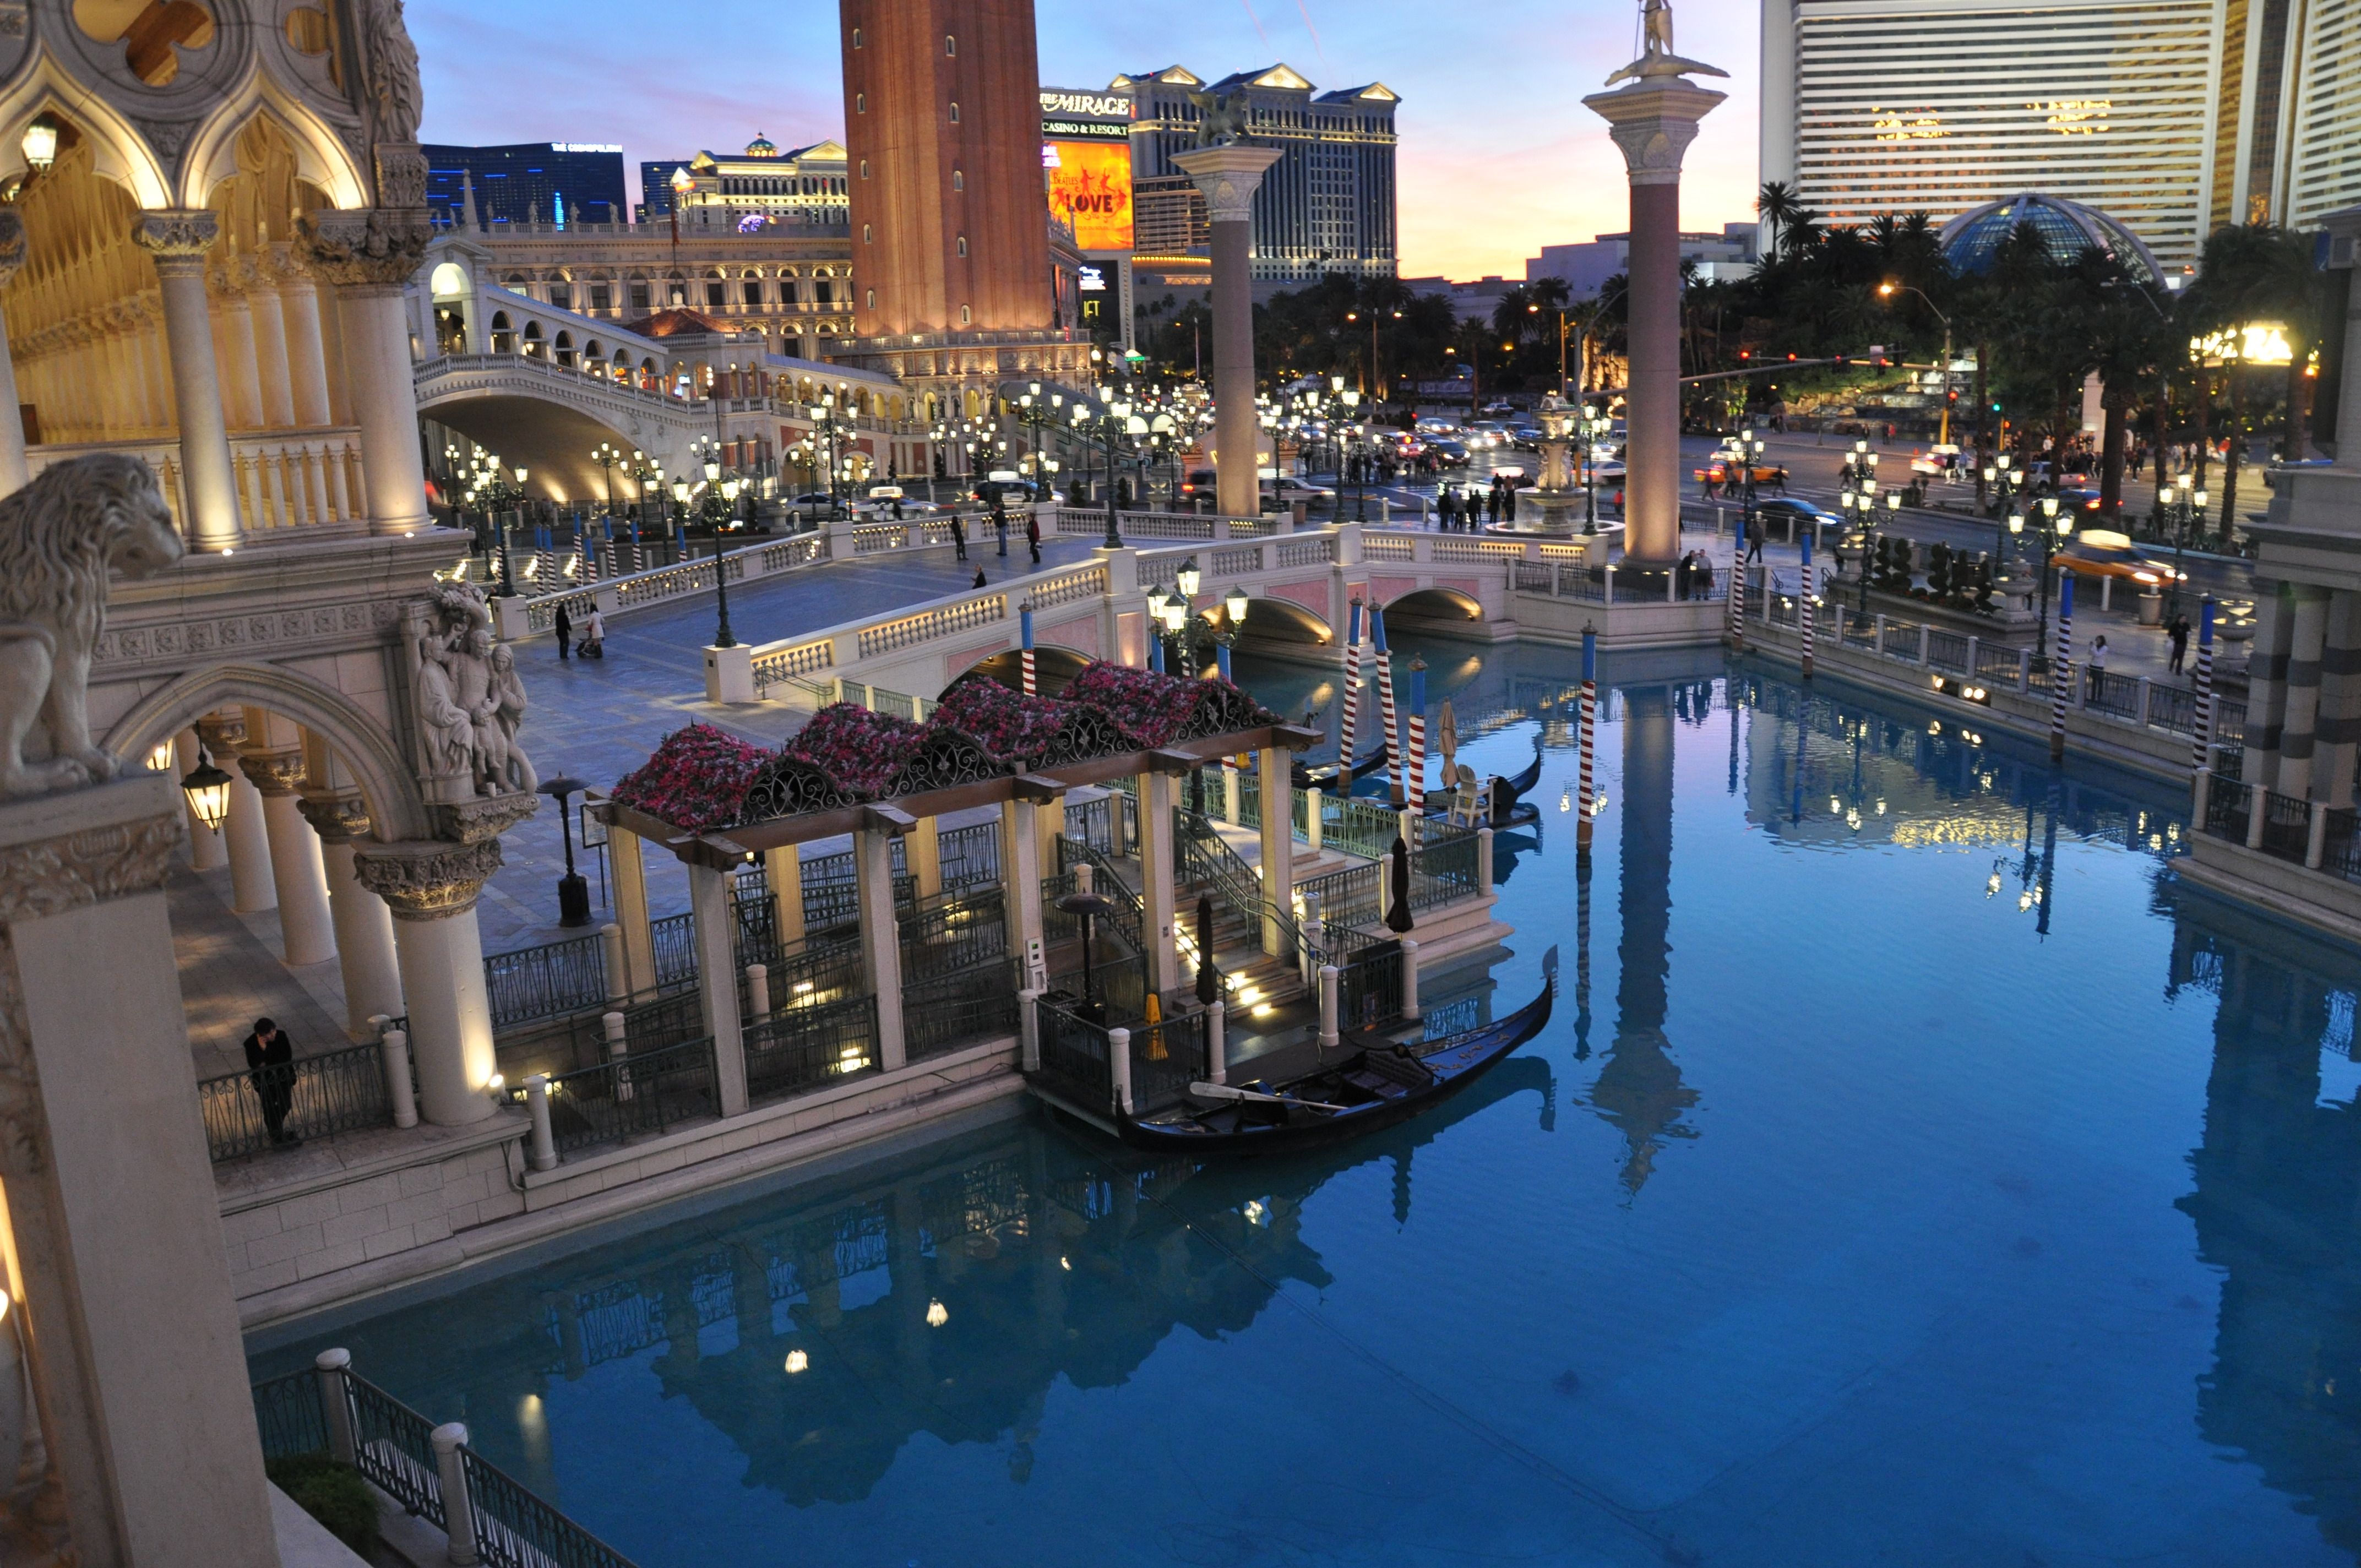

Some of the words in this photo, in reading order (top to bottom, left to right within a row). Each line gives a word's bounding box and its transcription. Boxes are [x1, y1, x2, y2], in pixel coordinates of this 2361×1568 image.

[1040, 93, 1059, 109] THE
[1059, 95, 1129, 116] MIRAGE
[1042, 122, 1079, 134] CASINO
[1080, 124, 1088, 134] &
[1089, 124, 1128, 136] RESORT
[1066, 194, 1113, 213] LOVE
